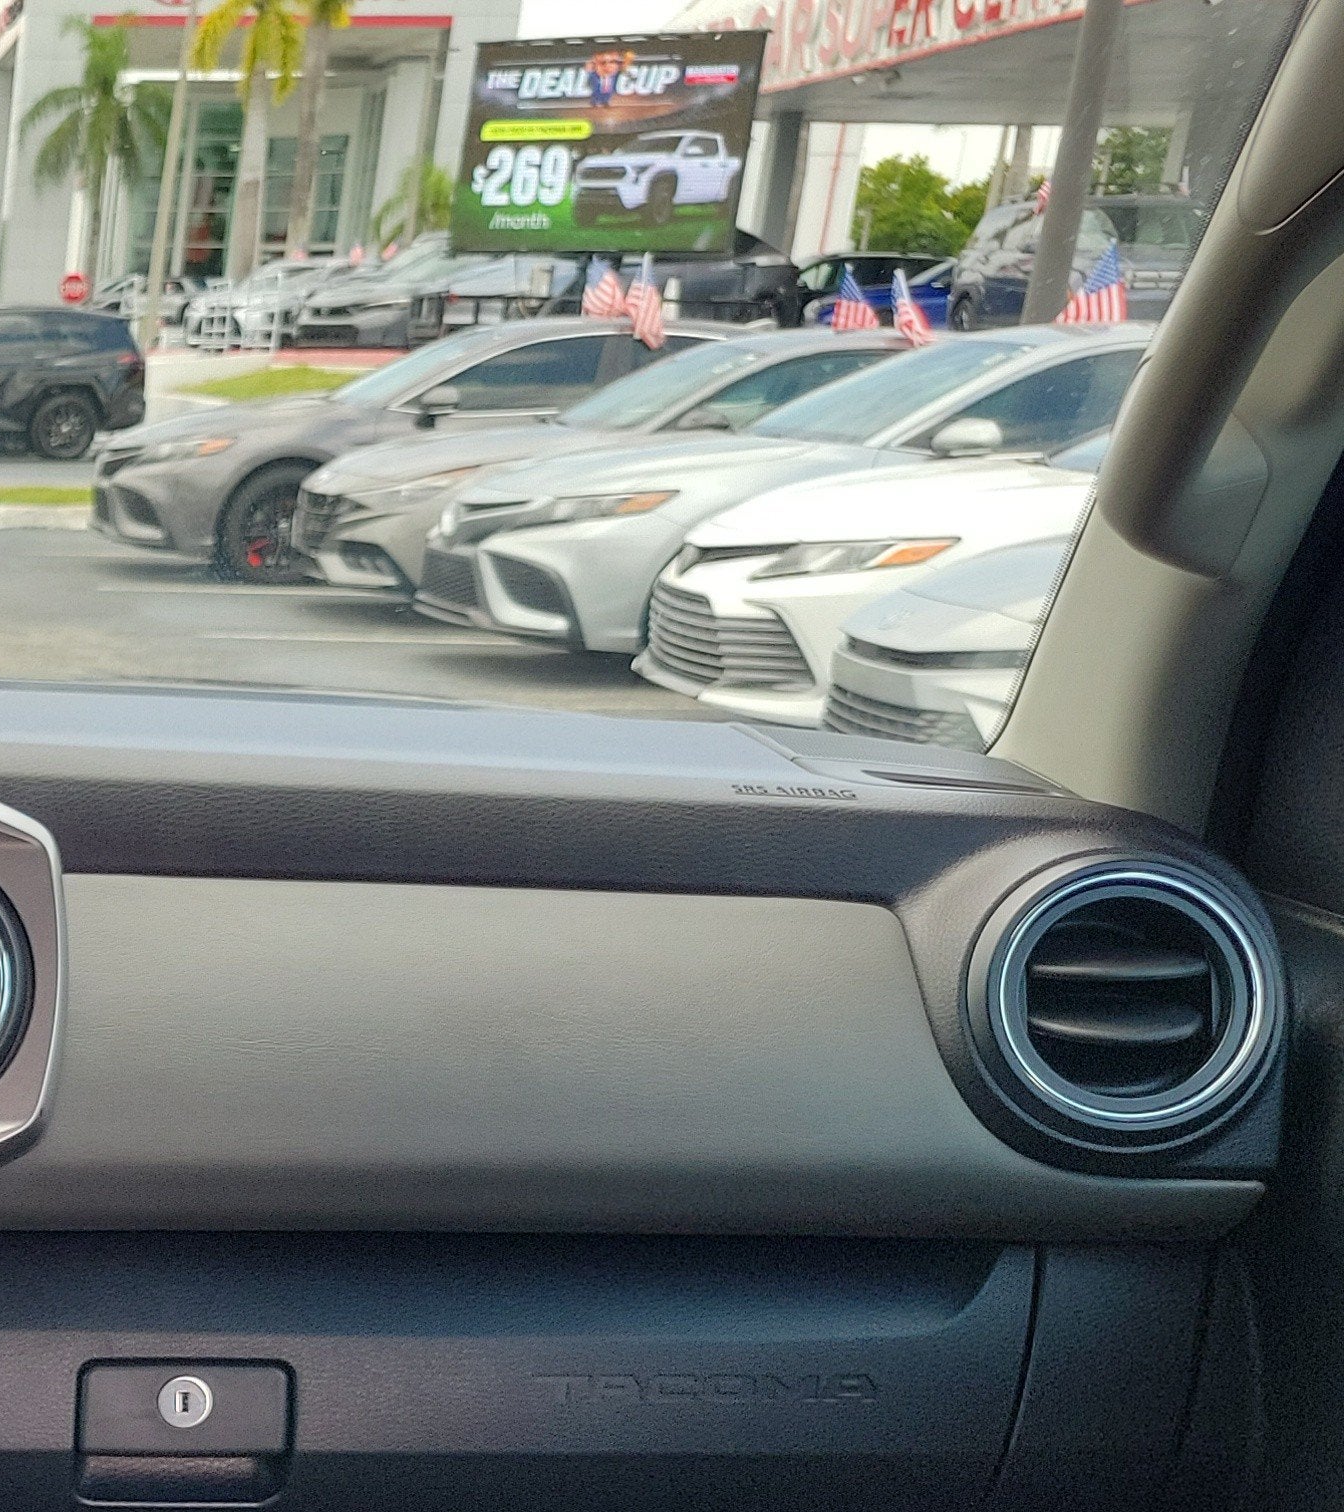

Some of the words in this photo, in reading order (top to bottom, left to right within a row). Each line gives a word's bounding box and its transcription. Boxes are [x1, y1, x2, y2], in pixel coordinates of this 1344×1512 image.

[486, 69, 521, 90] THE
[517, 67, 593, 100] DEAL
[615, 64, 681, 96] CUP
[731, 784, 769, 795] SRS
[775, 786, 857, 800] AIRBAG
[531, 1372, 877, 1402] TACOMA
